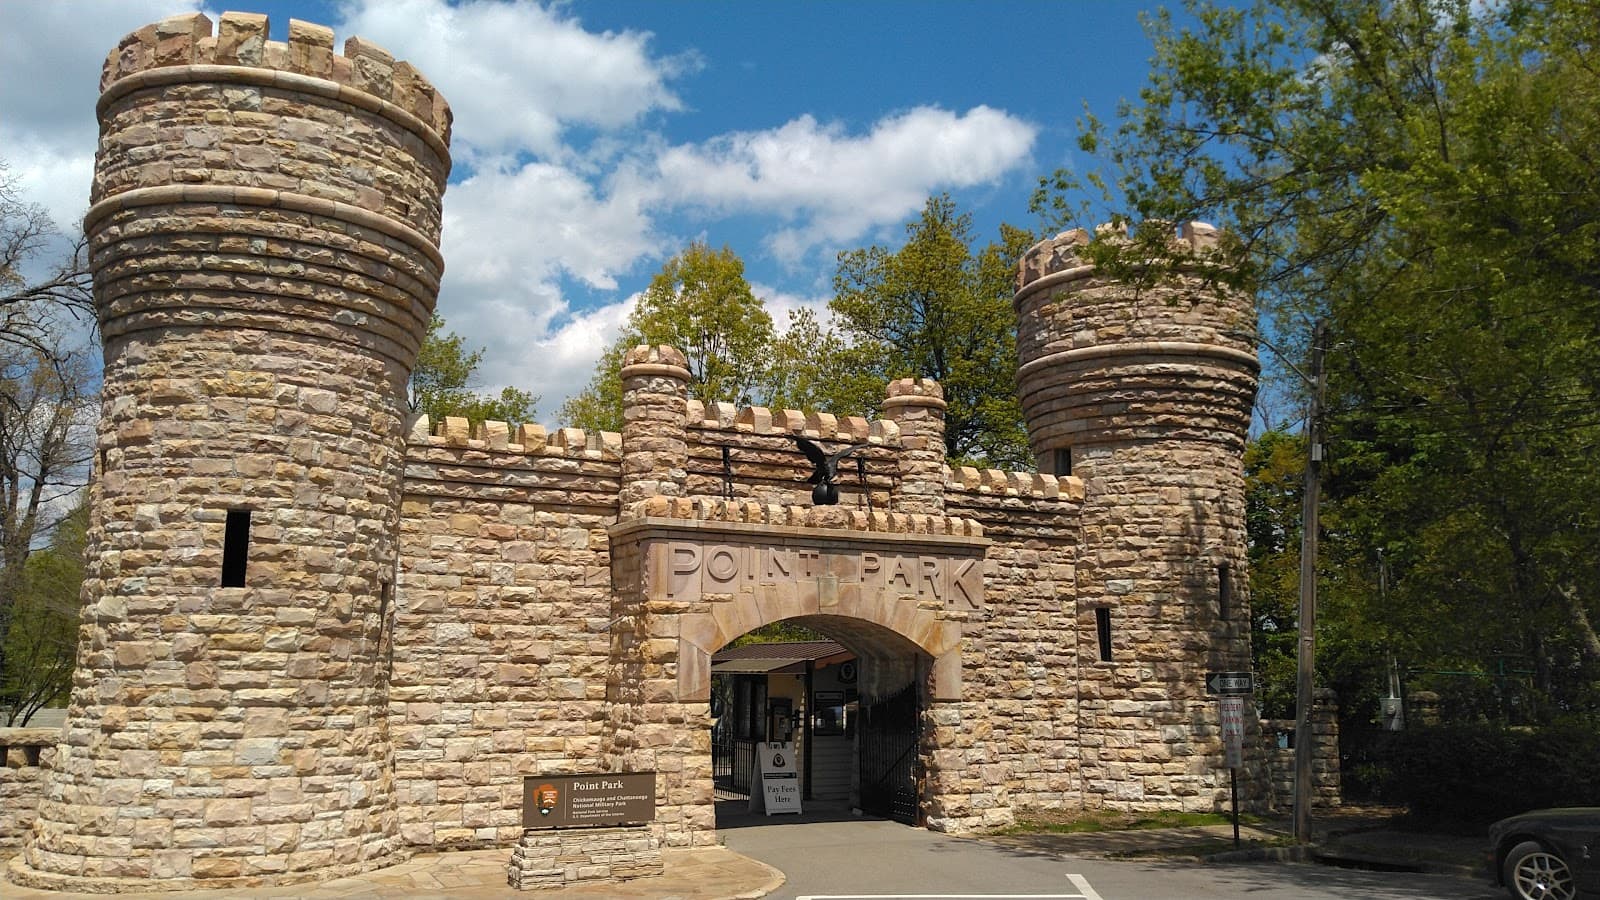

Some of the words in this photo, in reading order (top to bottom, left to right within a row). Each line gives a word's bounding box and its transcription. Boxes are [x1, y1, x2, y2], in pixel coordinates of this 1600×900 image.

[667, 541, 819, 597] POINT
[860, 552, 979, 610] PARK
[1220, 679, 1233, 688] ONE
[1234, 679, 1247, 688] WAY
[573, 782, 599, 790] Point
[602, 780, 624, 789] Park
[767, 785, 780, 794] Pay
[781, 785, 796, 793] Fees
[775, 795, 791, 803] Here
